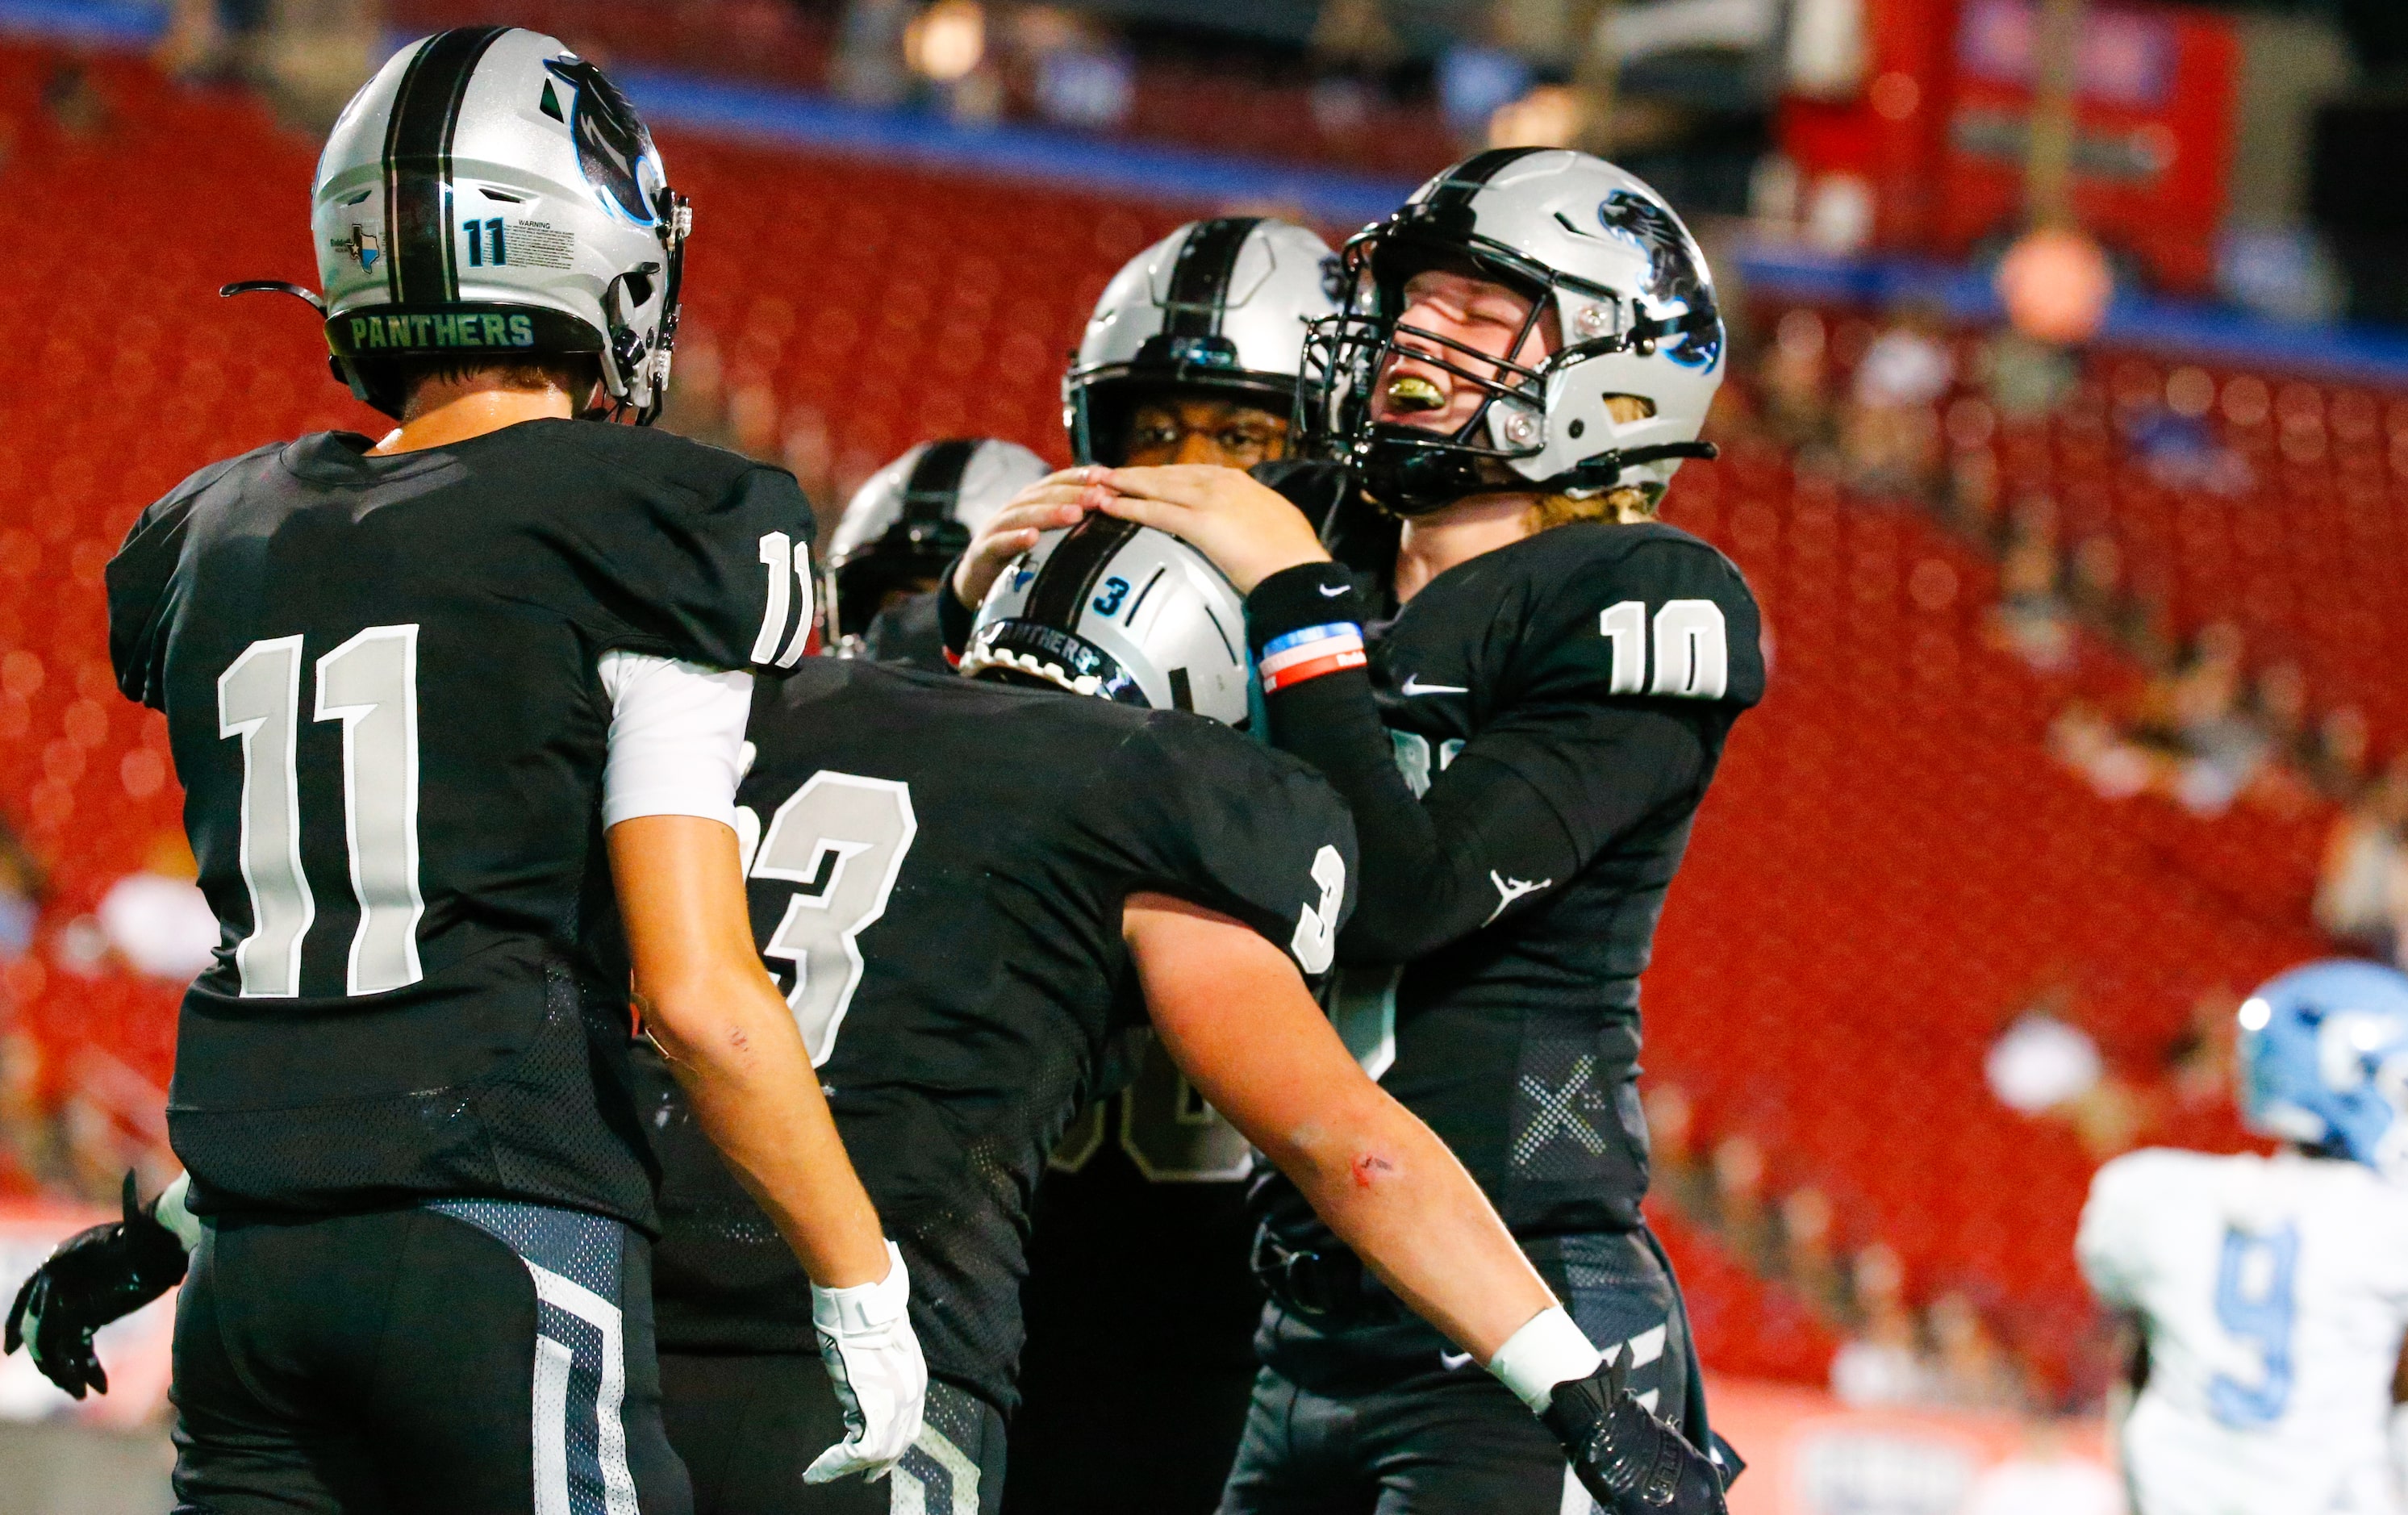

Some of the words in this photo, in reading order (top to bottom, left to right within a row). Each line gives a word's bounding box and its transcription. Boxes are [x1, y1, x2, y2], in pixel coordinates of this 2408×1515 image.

[462, 216, 507, 267] 11
[519, 219, 551, 229] WARNING
[350, 314, 534, 349] PANTHERS
[750, 531, 814, 669] 11
[1092, 576, 1130, 618] 3
[1600, 599, 1728, 699] 10
[217, 623, 426, 998] 11
[1291, 845, 1346, 974] 3
[2209, 1213, 2300, 1427] 9
